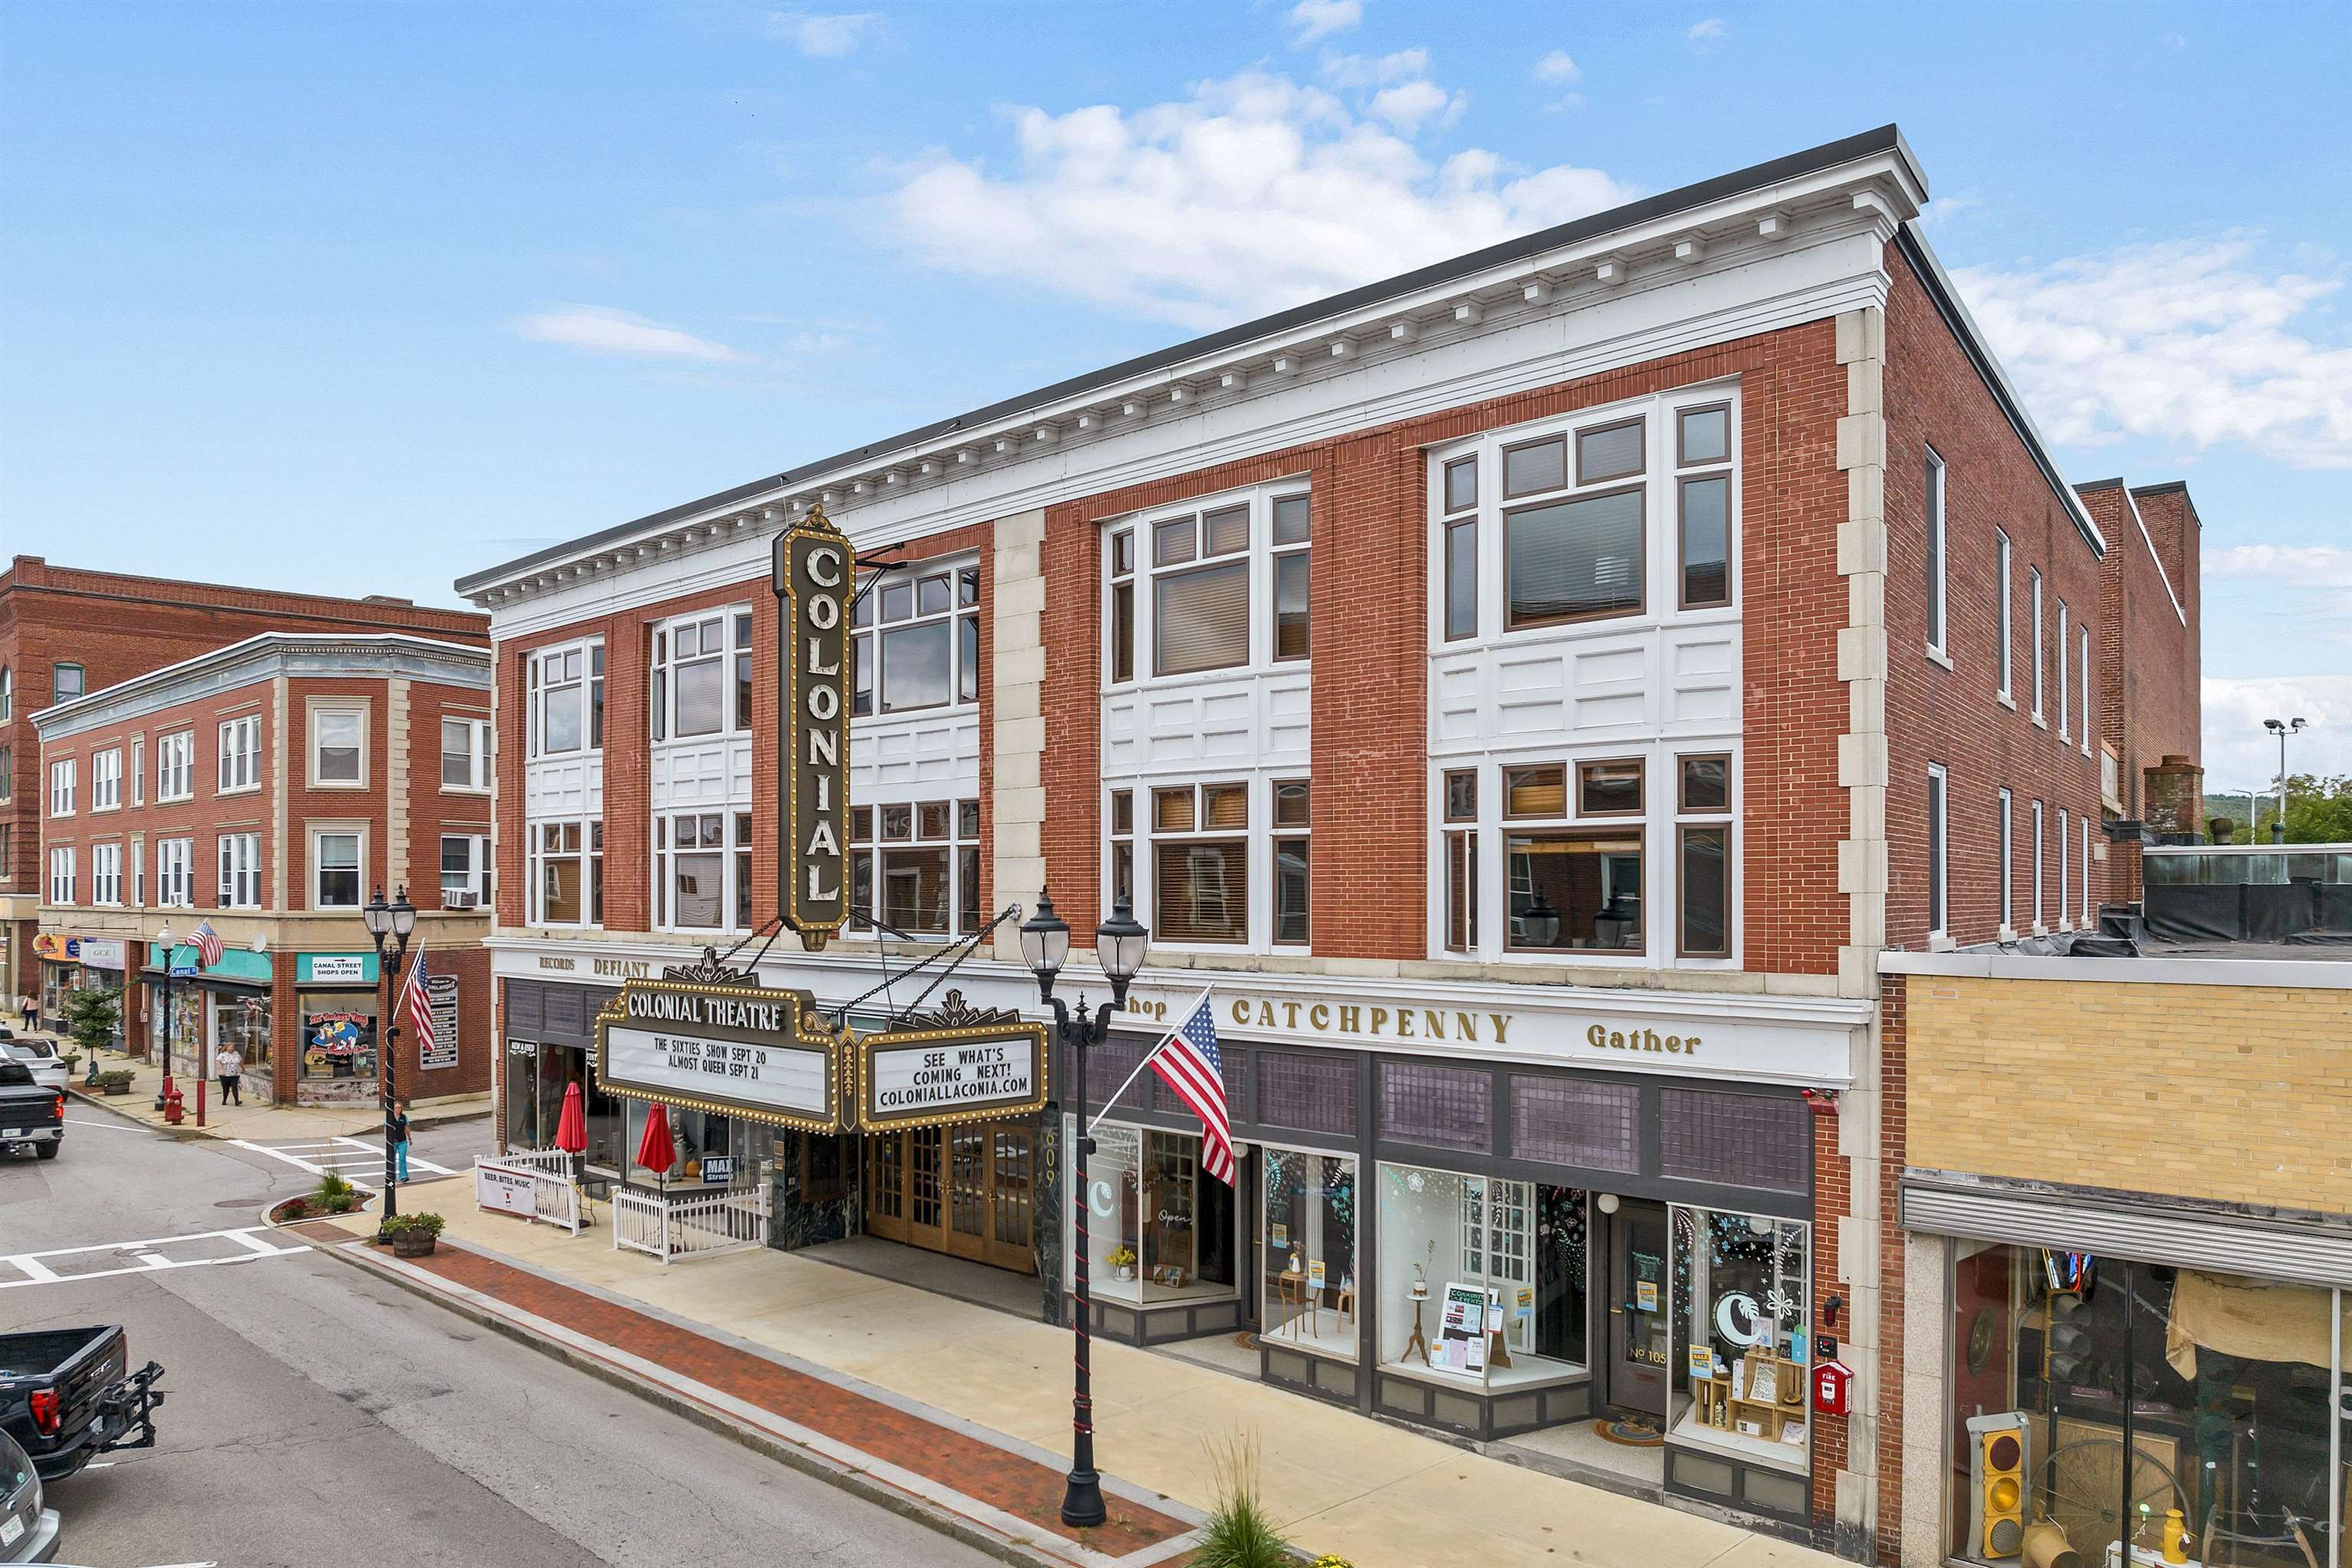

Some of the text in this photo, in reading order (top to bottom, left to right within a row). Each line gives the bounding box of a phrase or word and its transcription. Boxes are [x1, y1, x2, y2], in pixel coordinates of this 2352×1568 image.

[806, 547, 841, 901] COLONIAL
[171, 967, 191, 975] Canal
[539, 956, 650, 978] RECORDS DEFIANT
[628, 993, 783, 1031] COLONIAL THEATRE
[1129, 996, 1701, 1054] hop CATCHPENNY Gather
[654, 1037, 766, 1064] THE SIXTIES SHOW SEPT 20
[924, 1047, 1004, 1068] SEE WHAT'S
[668, 1055, 759, 1080] ALMOST QUEEN SEPT 21
[913, 1063, 1011, 1086] COMING NEXT!
[880, 1078, 1027, 1106] COLONIALLACONIA.COM
[707, 1159, 733, 1173] MAX
[1046, 1127, 1054, 1187] 609
[484, 1172, 530, 1188] BEER, BITES, MUSIC
[1158, 1209, 1192, 1228] Open
[1451, 1290, 1484, 1300] COMMUNIT
[1648, 1351, 1667, 1364] 105
